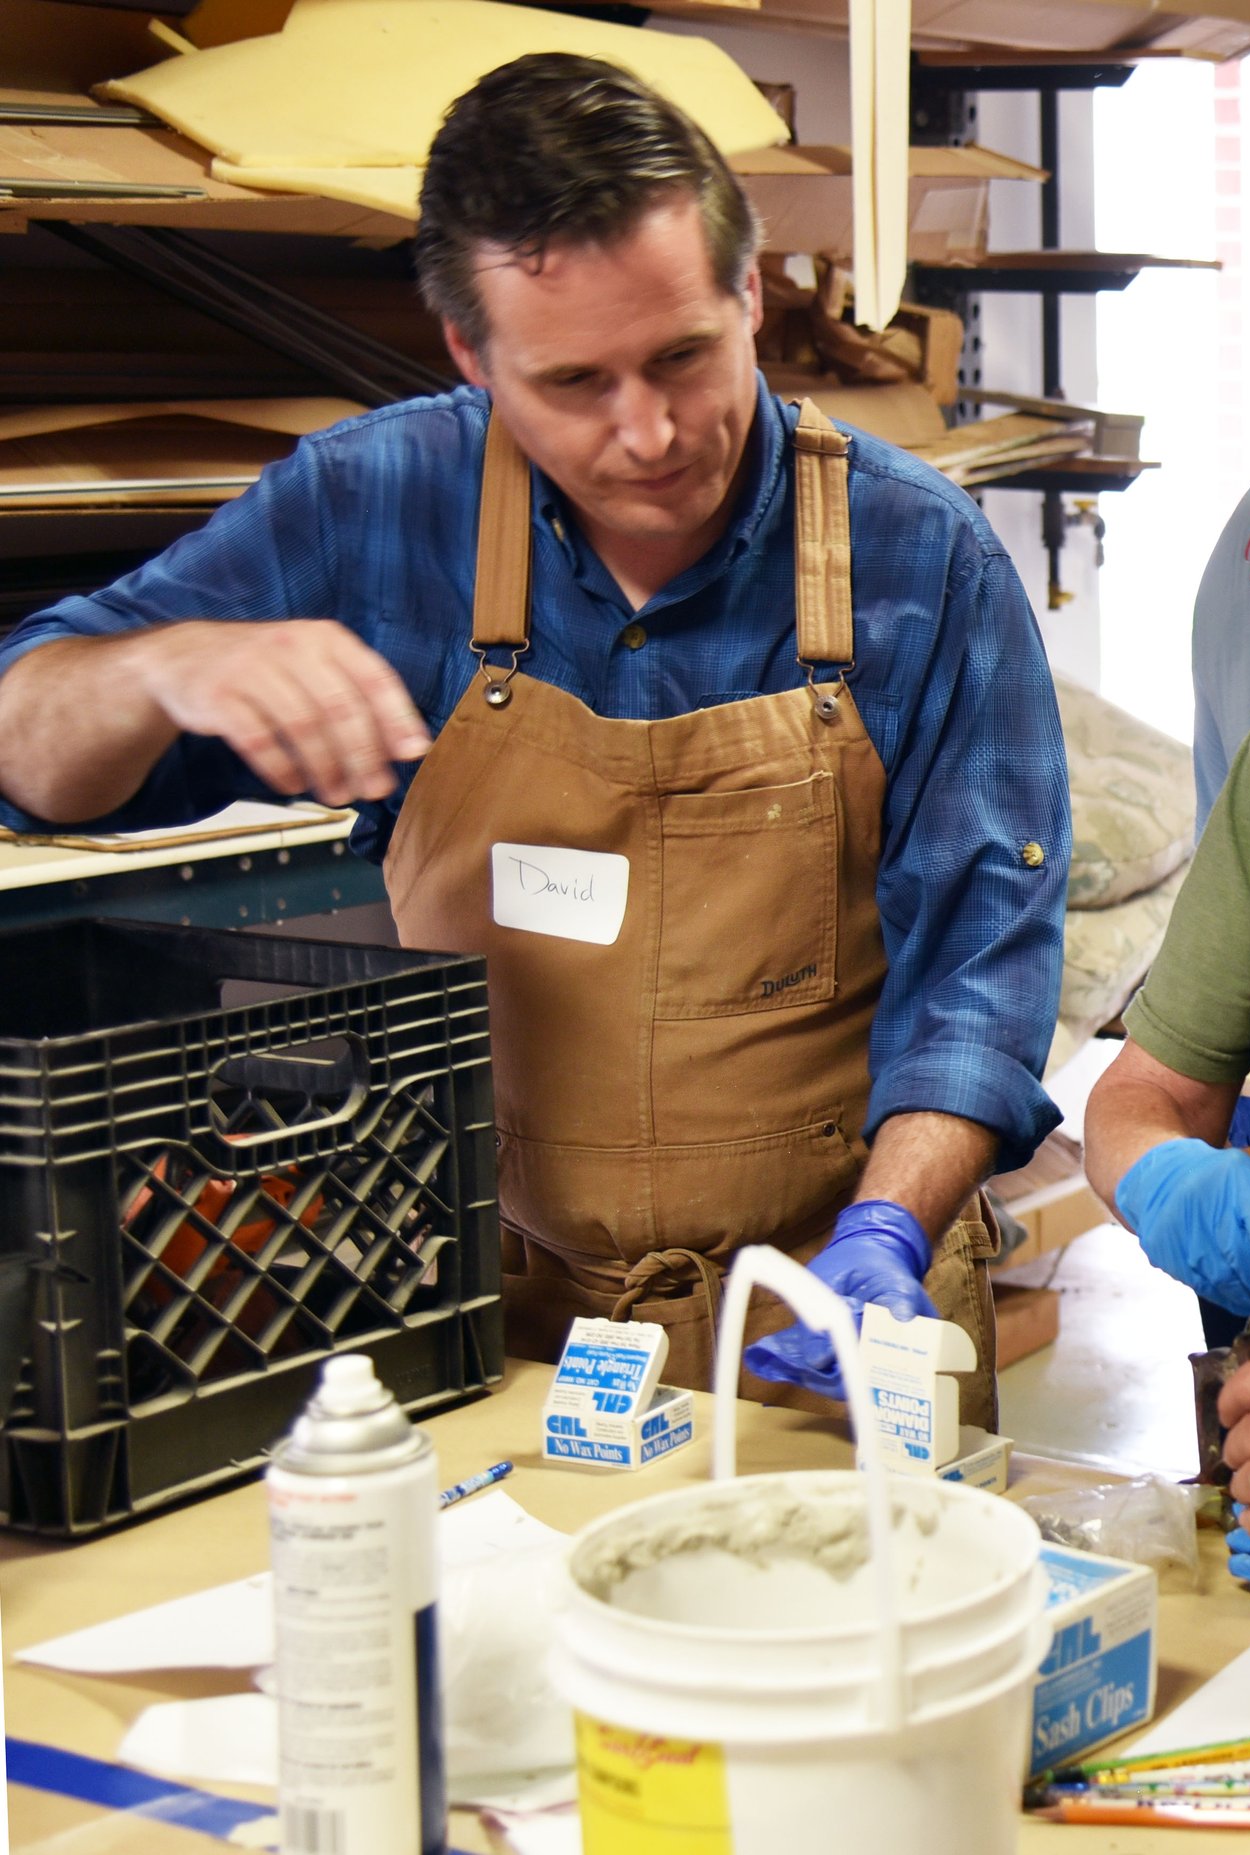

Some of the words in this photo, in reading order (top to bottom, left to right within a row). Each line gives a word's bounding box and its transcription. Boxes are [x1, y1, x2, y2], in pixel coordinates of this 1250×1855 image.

[508, 856, 595, 902] David
[554, 1438, 569, 1456] No
[570, 1440, 593, 1458] Wax
[593, 1443, 624, 1461] Points
[1035, 1701, 1081, 1757] Sash
[1086, 1681, 1134, 1730] Clips
